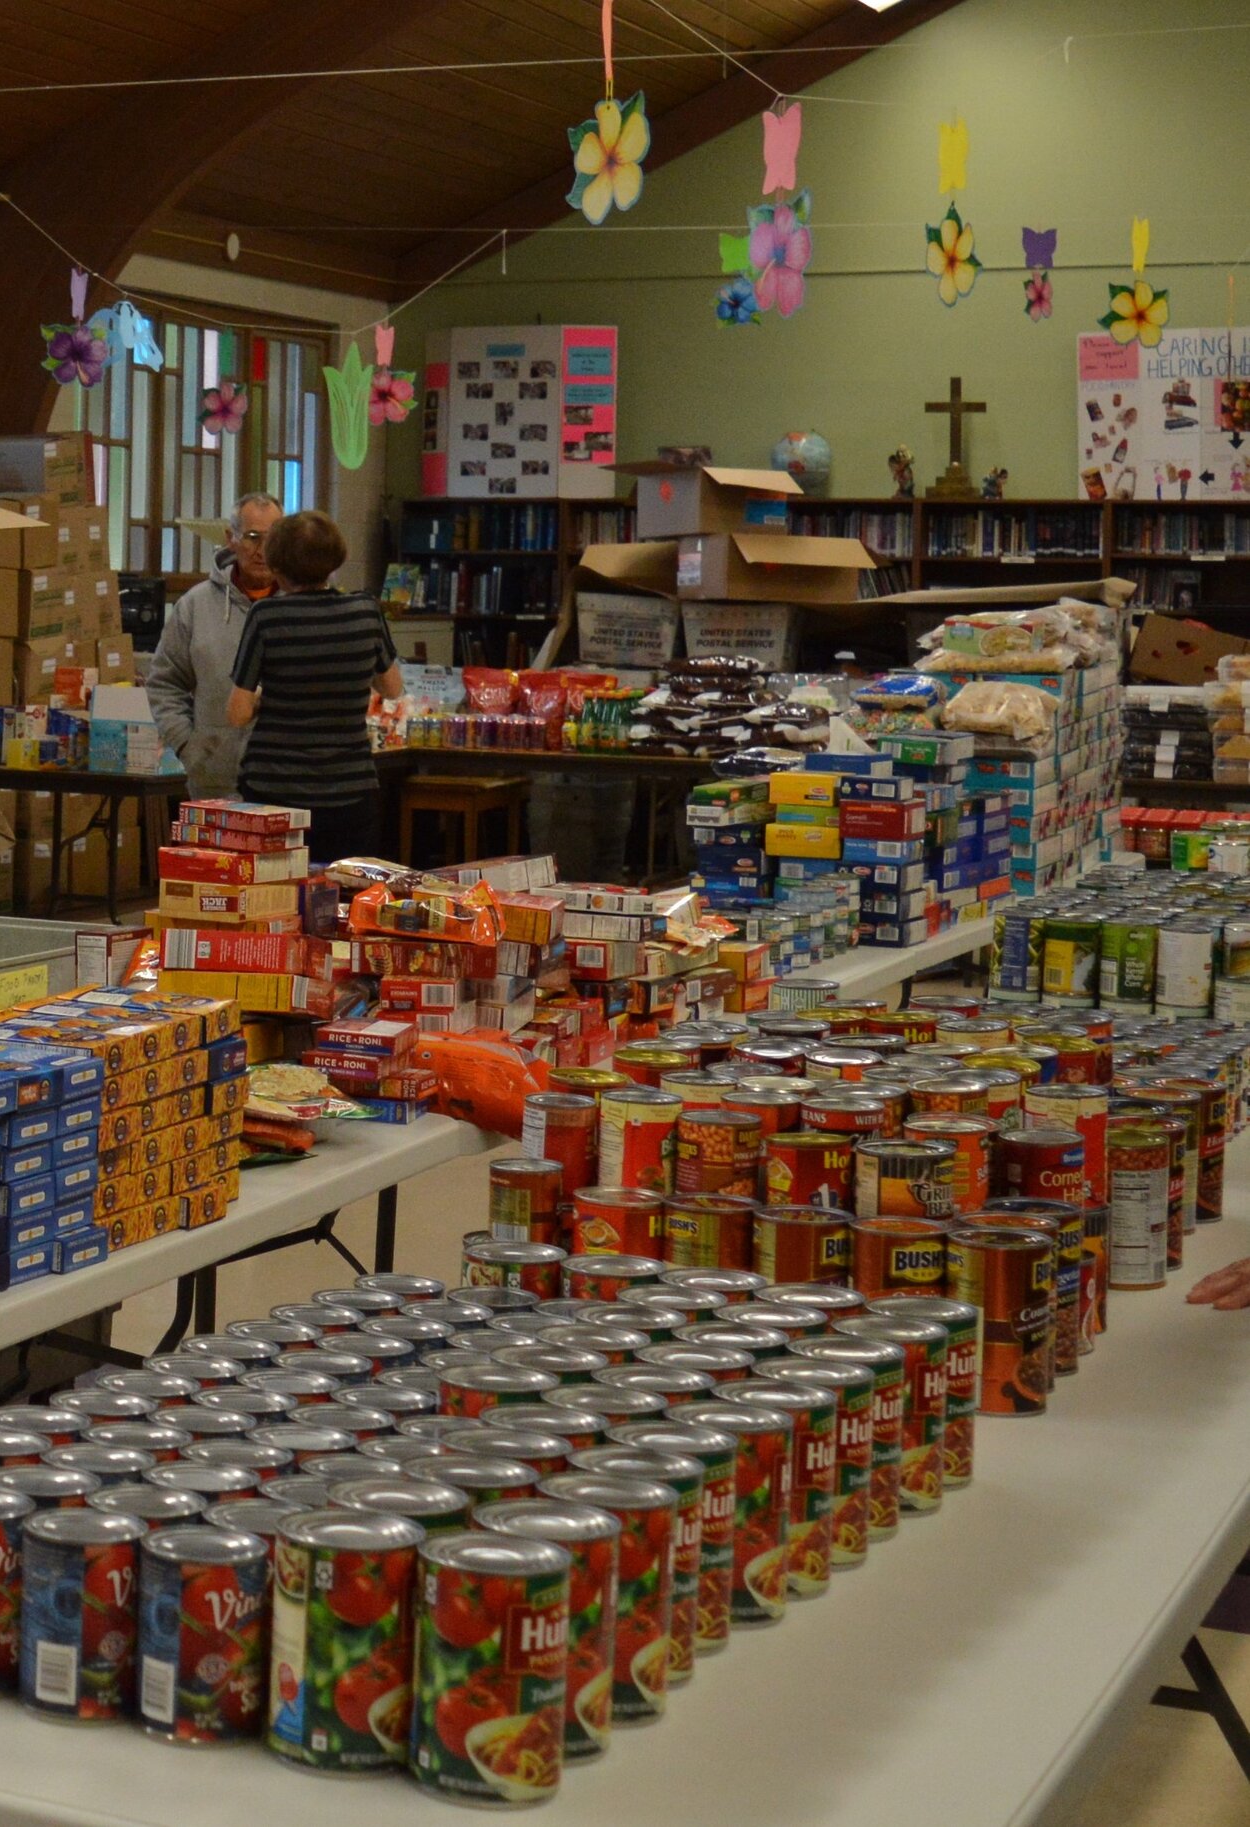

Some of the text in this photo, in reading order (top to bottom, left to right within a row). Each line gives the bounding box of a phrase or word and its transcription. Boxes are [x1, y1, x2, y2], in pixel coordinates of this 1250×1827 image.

[1157, 335, 1228, 357] CARING
[1147, 355, 1250, 378] HELPING OTHE
[594, 628, 660, 638] UNITED STATES
[701, 628, 771, 637] UNITED STATES
[590, 636, 662, 648] POSTAL SERVICE
[696, 639, 775, 648] POSTAL SERVICE
[202, 898, 227, 906] JACK
[328, 1033, 351, 1044] RICE
[358, 1036, 382, 1046] RONI
[904, 1028, 932, 1044] Ho
[314, 1056, 337, 1067] RICE
[343, 1060, 366, 1070] RONI
[824, 1151, 849, 1168] Ho
[1063, 1188, 1084, 1202] Ha
[895, 1250, 943, 1271] BUSH
[924, 1371, 947, 1398] Hu
[806, 1441, 835, 1470] Hu
